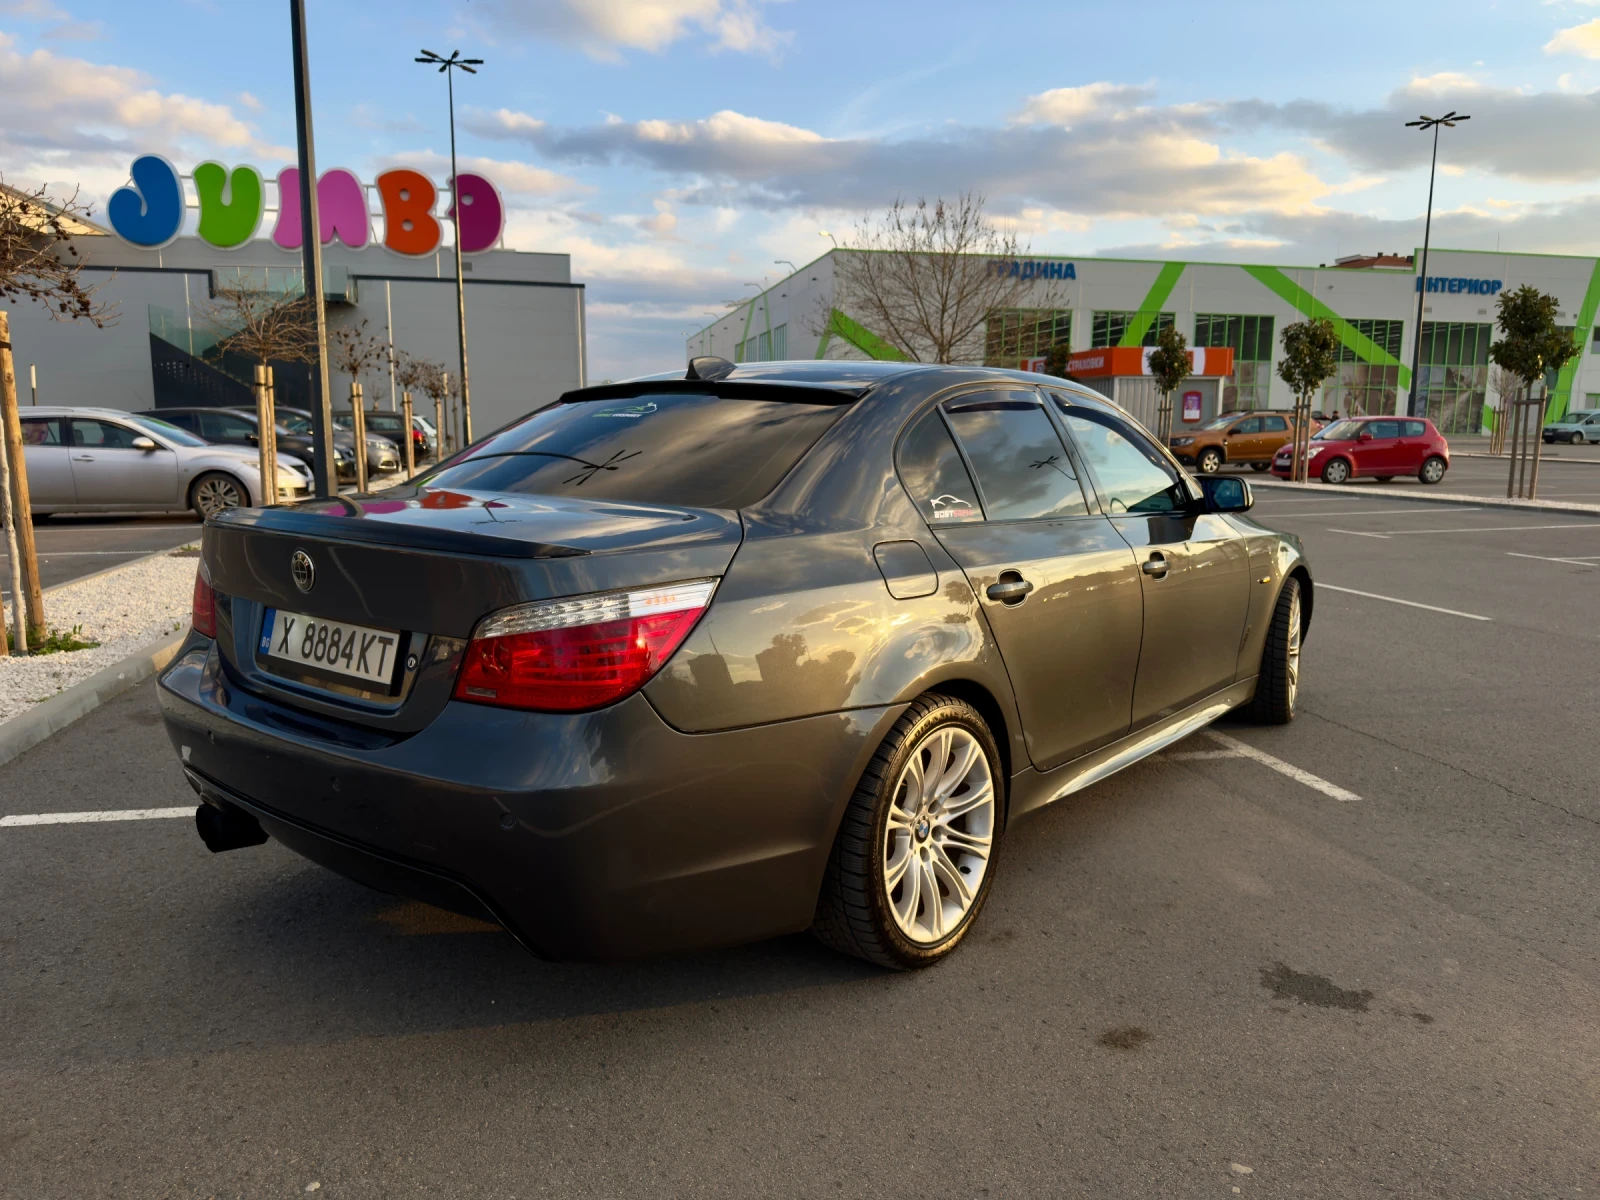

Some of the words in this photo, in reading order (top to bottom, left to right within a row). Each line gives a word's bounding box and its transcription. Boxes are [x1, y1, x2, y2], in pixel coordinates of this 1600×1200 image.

[106, 153, 504, 257] JUMBO
[987, 259, 1077, 281] ГРАДИНА
[1415, 276, 1503, 296] ИНТЕРИОР
[261, 636, 271, 648] BG
[278, 616, 295, 655] X
